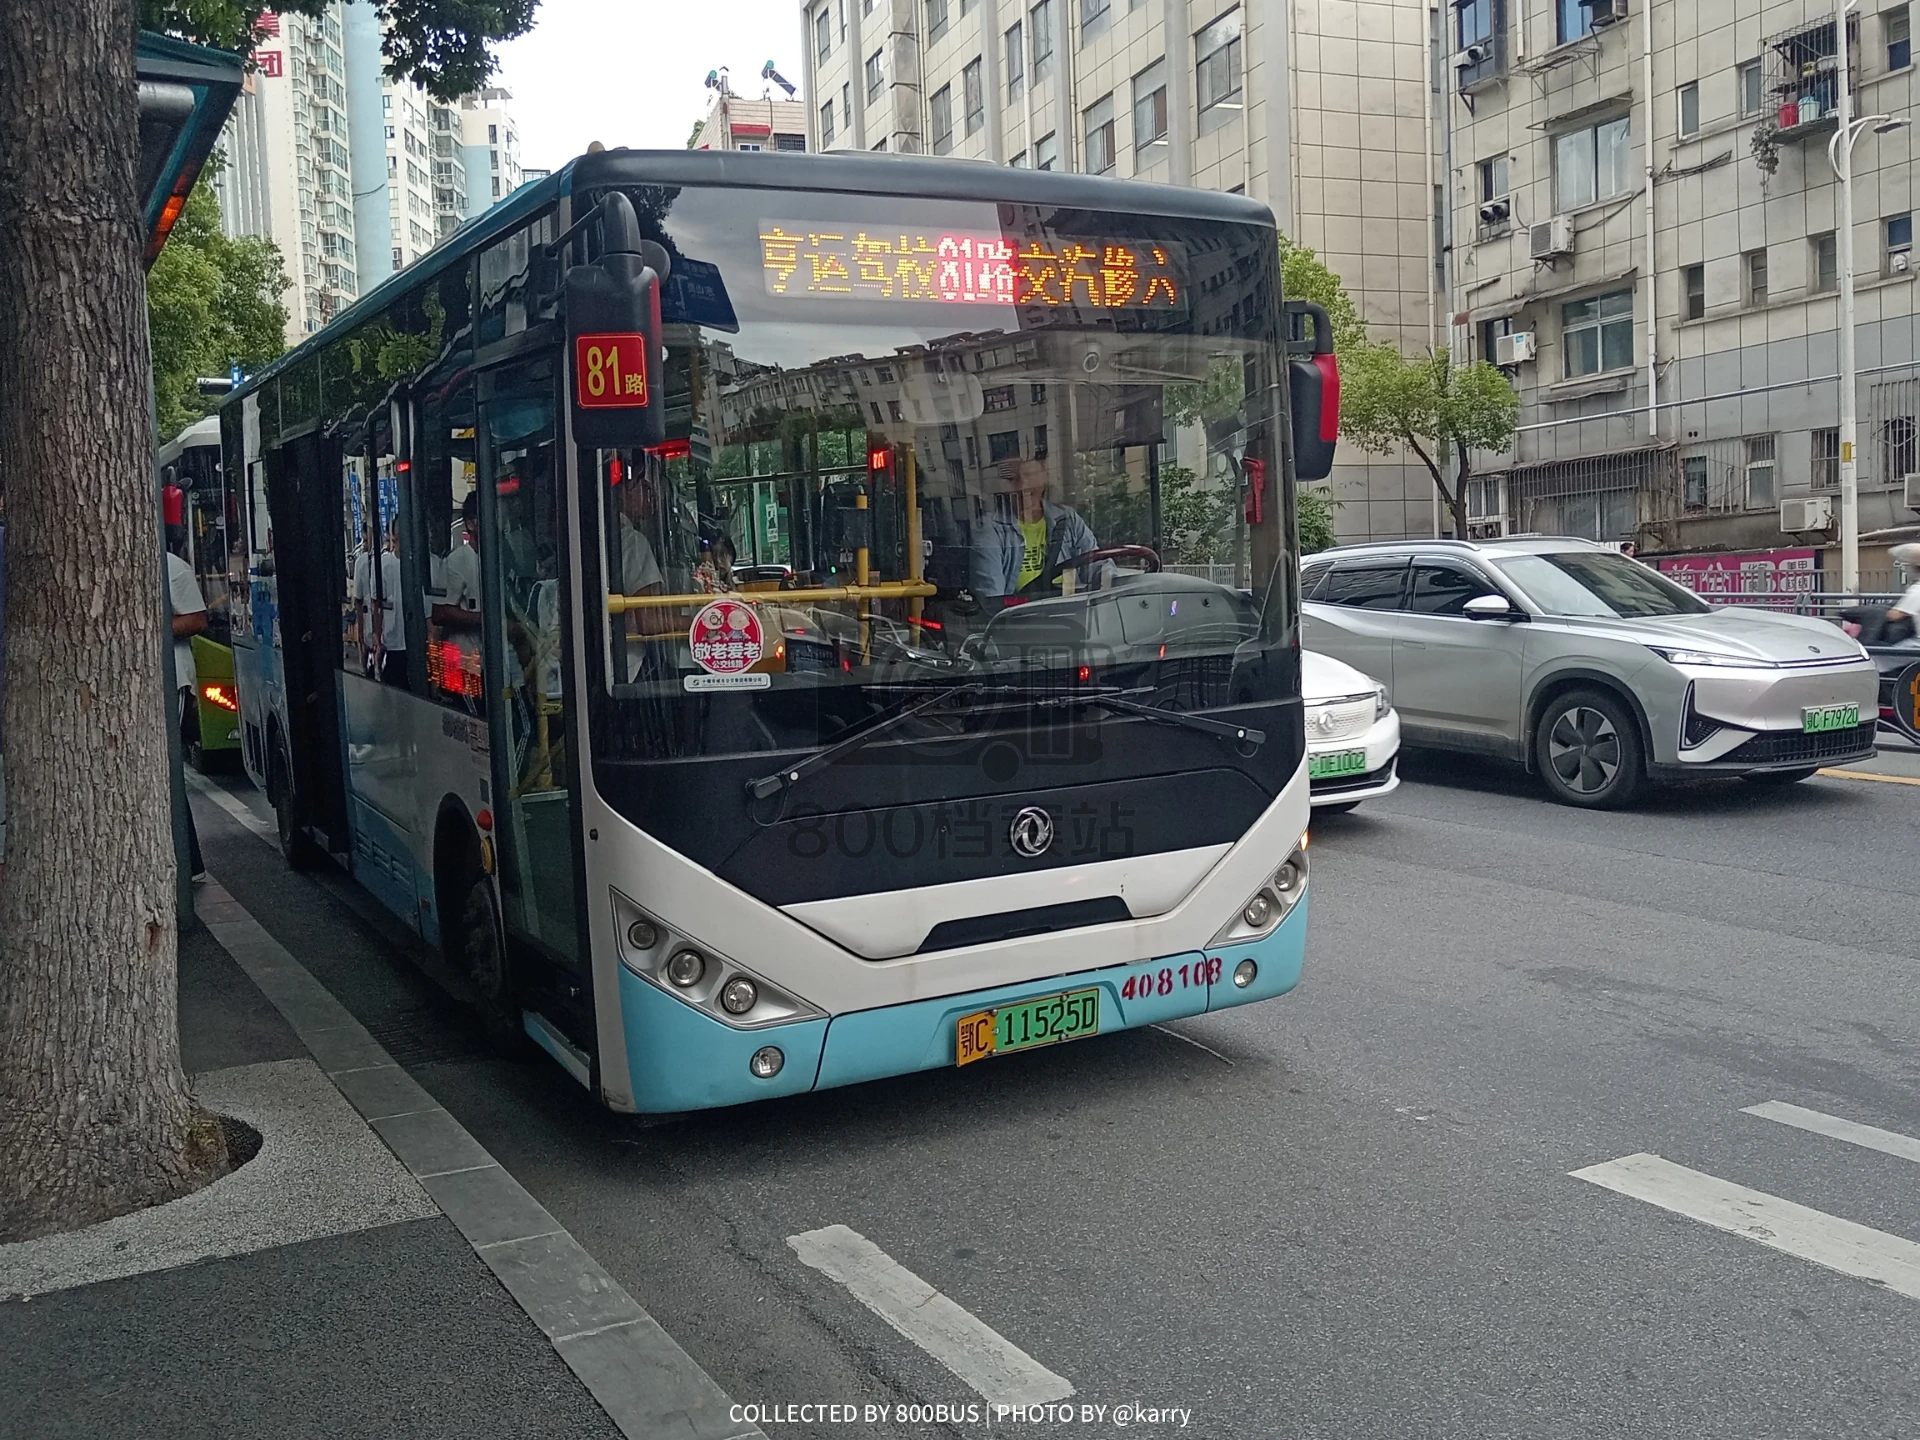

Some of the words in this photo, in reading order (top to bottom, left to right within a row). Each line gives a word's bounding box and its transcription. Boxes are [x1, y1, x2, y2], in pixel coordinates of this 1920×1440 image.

[587, 345, 644, 397] 81路
[694, 642, 760, 660] 敬老爱老
[1121, 957, 1222, 1001] 408108
[1003, 997, 1096, 1046] 11525D
